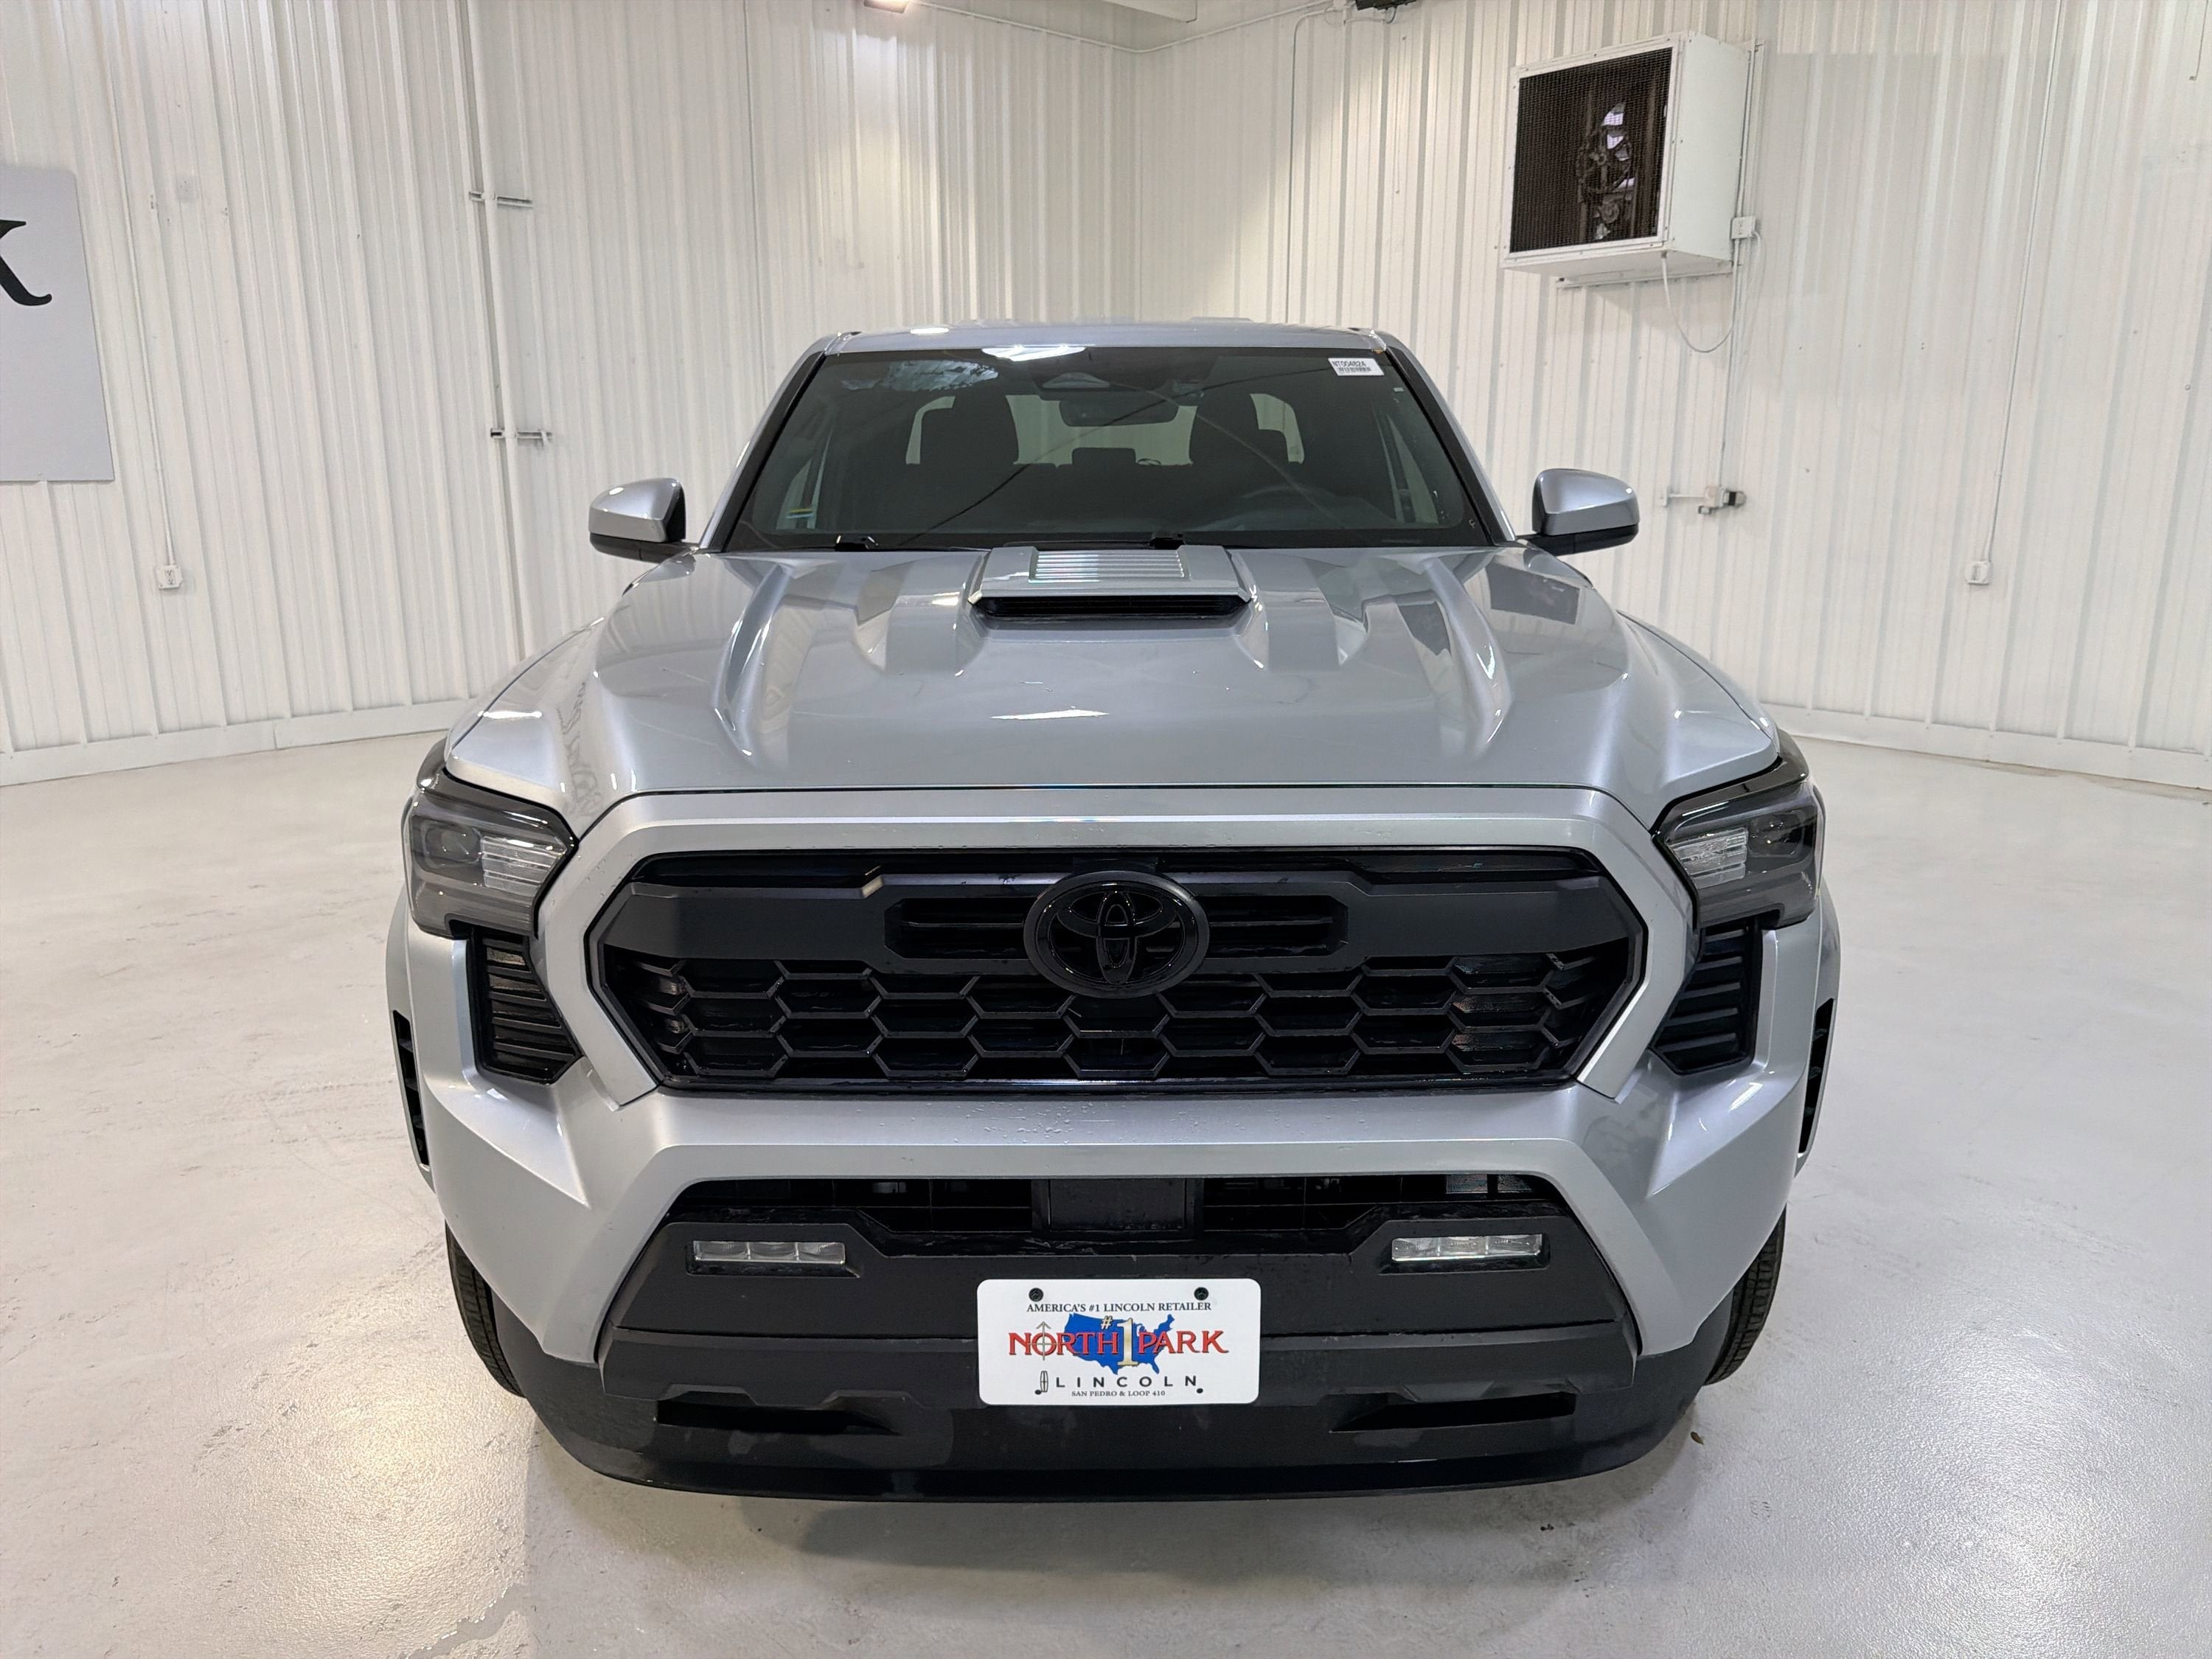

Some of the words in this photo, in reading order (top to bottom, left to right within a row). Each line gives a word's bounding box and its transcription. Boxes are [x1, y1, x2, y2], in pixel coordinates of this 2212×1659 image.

[1026, 1303, 1086, 1312] AMERICA'S
[1088, 1304, 1100, 1312] #1
[1103, 1303, 1155, 1312] LINCOLN
[1158, 1302, 1212, 1311] RETAILER
[1008, 1332, 1119, 1356] NORTH
[1138, 1330, 1230, 1354] PARK
[1056, 1375, 1197, 1388] LINCOLN
